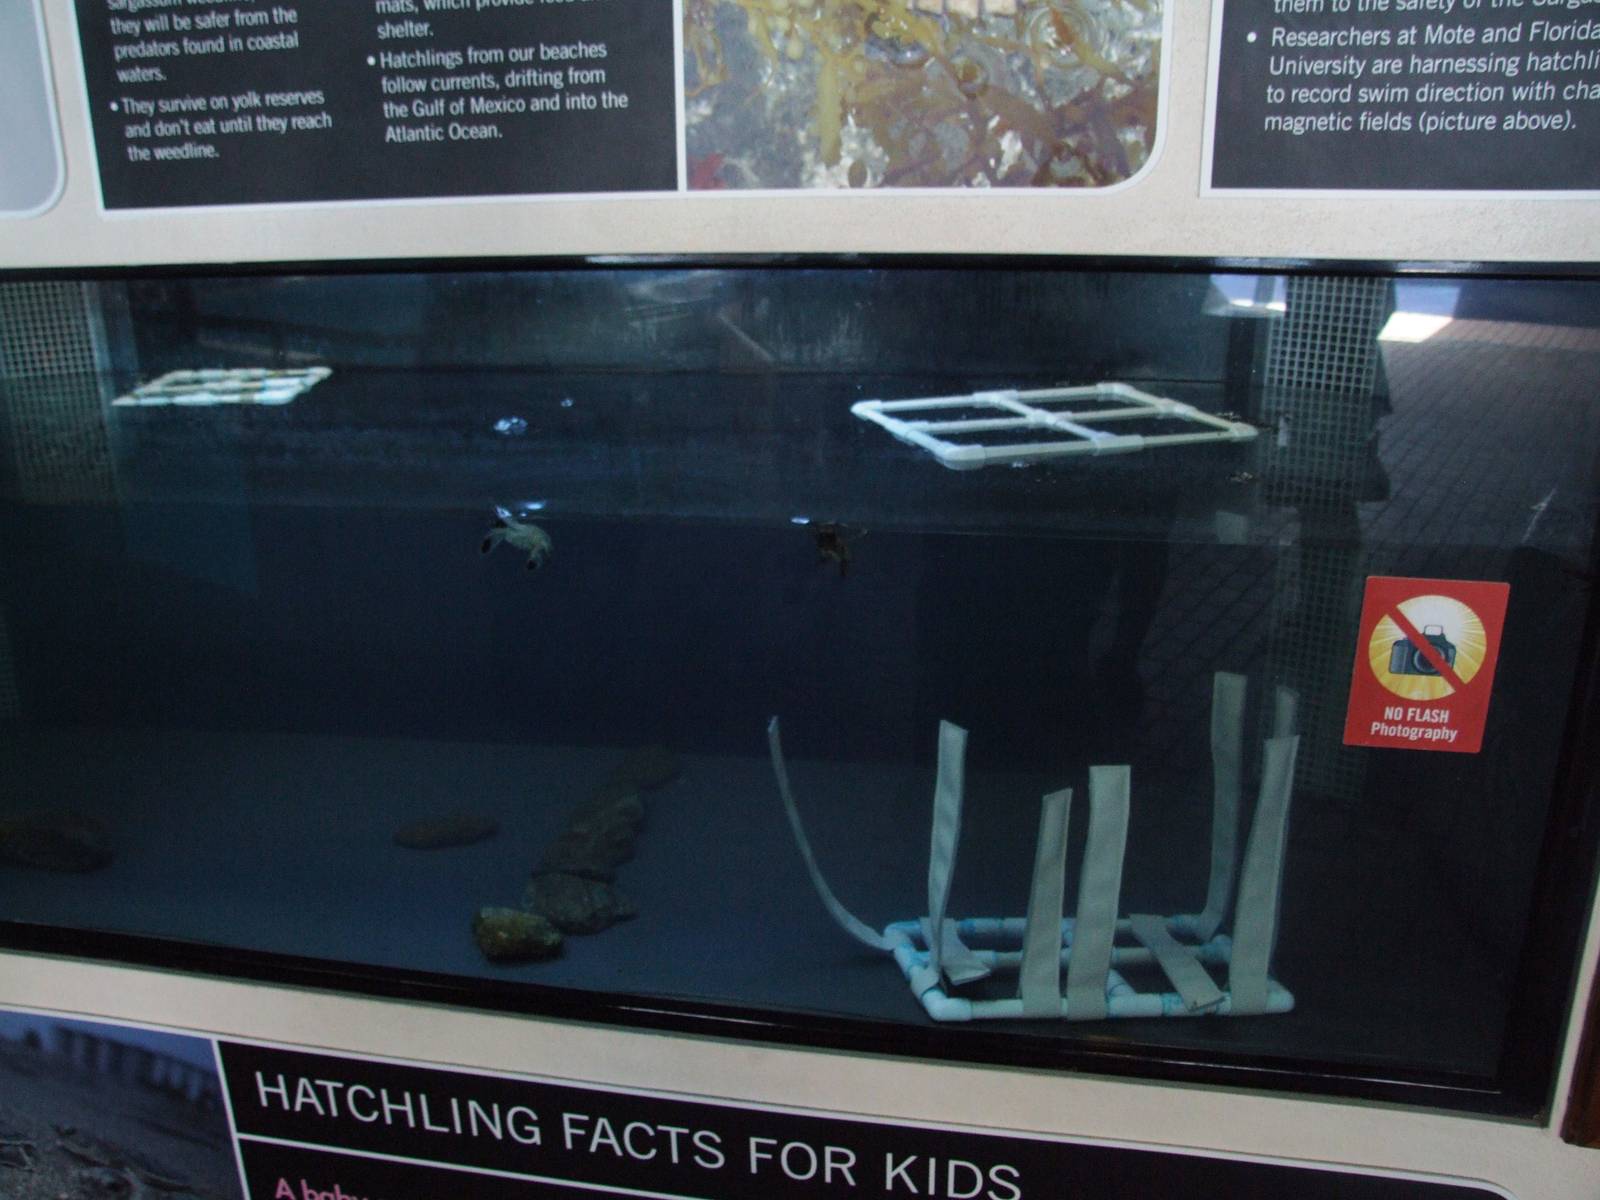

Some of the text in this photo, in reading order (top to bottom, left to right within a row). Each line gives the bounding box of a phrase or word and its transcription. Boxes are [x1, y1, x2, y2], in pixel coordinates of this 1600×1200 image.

[375, 0, 419, 14] mats,
[1273, 0, 1324, 13] them
[1331, 0, 1350, 12] to
[1357, 0, 1389, 12] the
[1395, 0, 1453, 14] safety
[110, 7, 298, 37] they will be safer from the
[377, 21, 434, 40] shelter.
[1271, 19, 1600, 47] Researchers at Mote and Florida
[114, 31, 299, 62] predators found in coastal
[379, 41, 608, 70] Hatchlings from our beaches
[116, 66, 167, 83] waters.
[1269, 55, 1366, 79] University
[1371, 57, 1402, 75] are
[1408, 53, 1520, 77] harnessing
[381, 67, 606, 94] follow currents, drifting from
[1266, 86, 1285, 104] to
[1291, 84, 1352, 104] record
[1358, 84, 1409, 103] swim
[1416, 83, 1505, 103] direction
[1512, 80, 1556, 101] with
[121, 90, 325, 117] They survive on yolk reserves
[383, 91, 629, 119] the Gulf of Mexico and into the
[124, 112, 333, 139] and don't eat until they reach
[385, 122, 503, 143] Atlantic Ocean.
[1264, 108, 1577, 135] magnetic fields (picture above).
[127, 141, 220, 163] the weedline.
[1384, 706, 1449, 723] NO FLASH
[1370, 721, 1458, 743] Photography
[255, 1070, 1022, 1200] HATCHLING FACTS FOR KIDS
[275, 1178, 369, 1200] A bab
